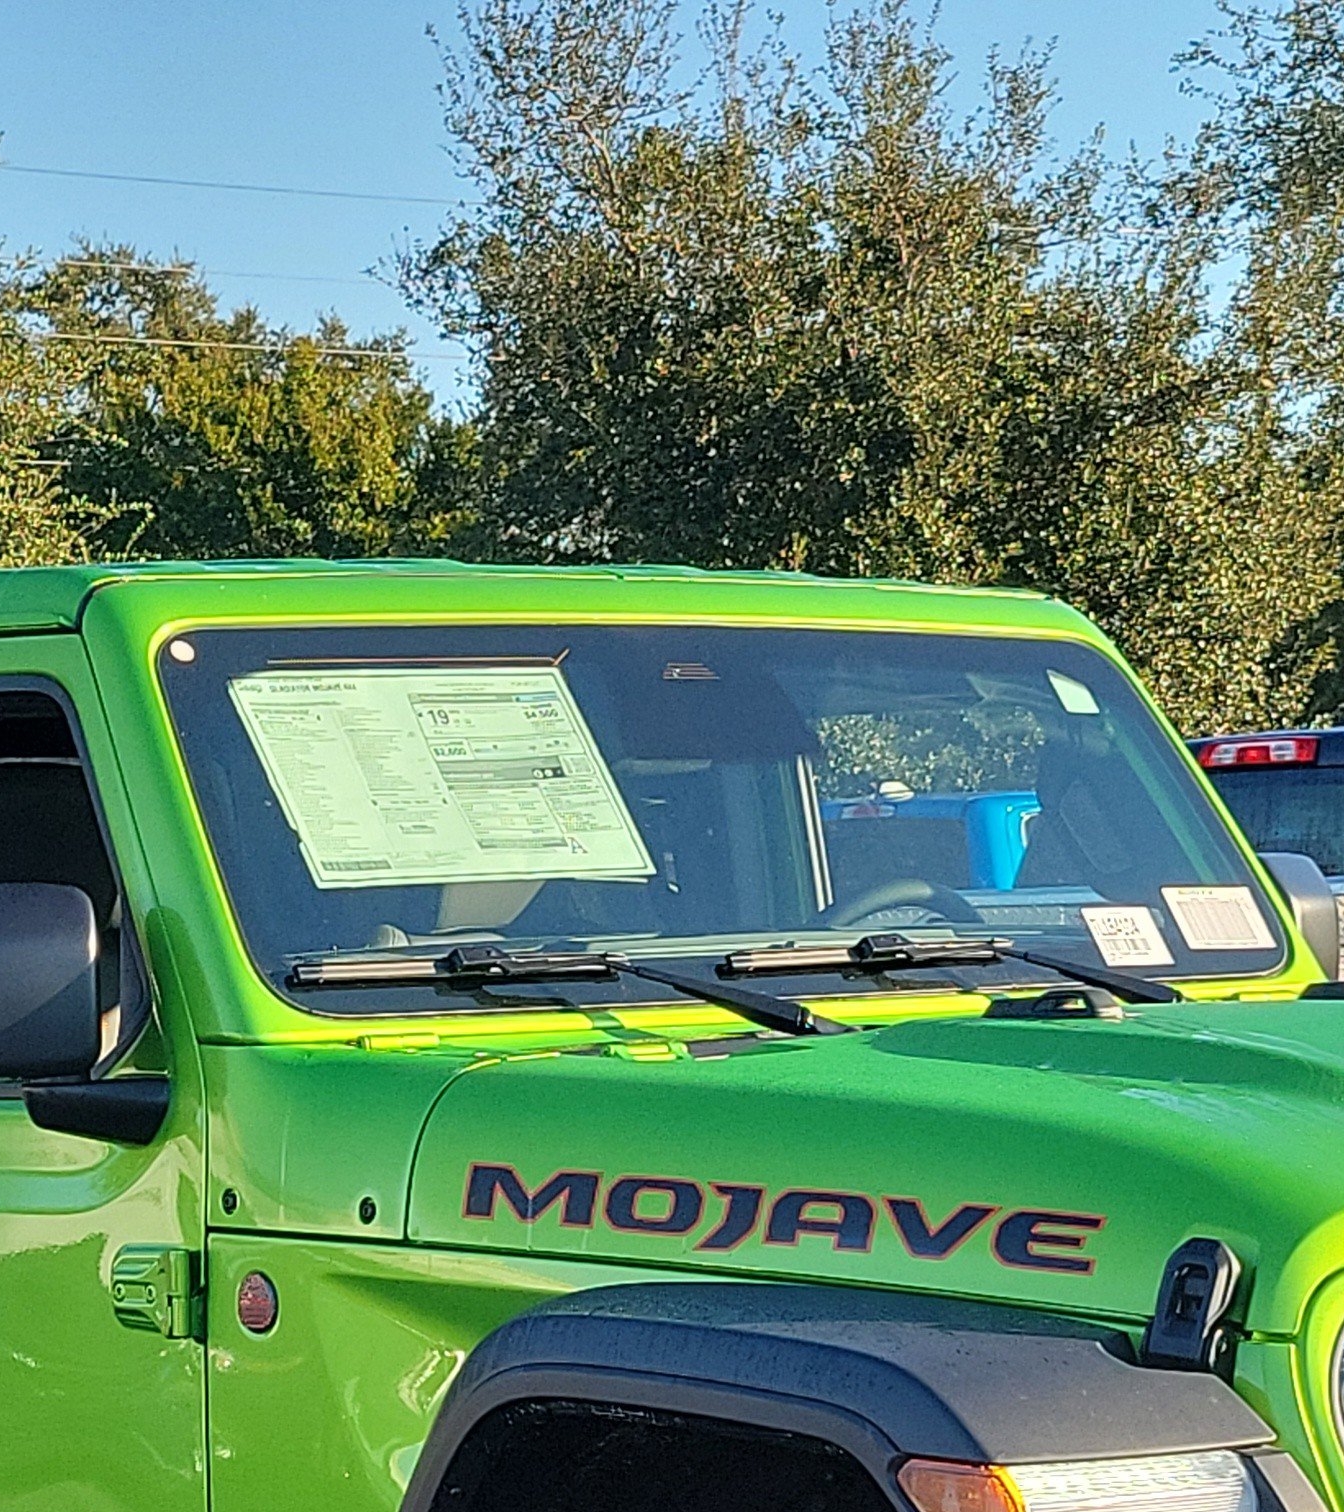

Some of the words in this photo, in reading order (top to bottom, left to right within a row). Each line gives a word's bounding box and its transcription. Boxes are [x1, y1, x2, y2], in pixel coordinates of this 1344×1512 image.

[426, 709, 450, 725] 19
[567, 836, 589, 854] A
[461, 1162, 1106, 1277] MOJAVE
